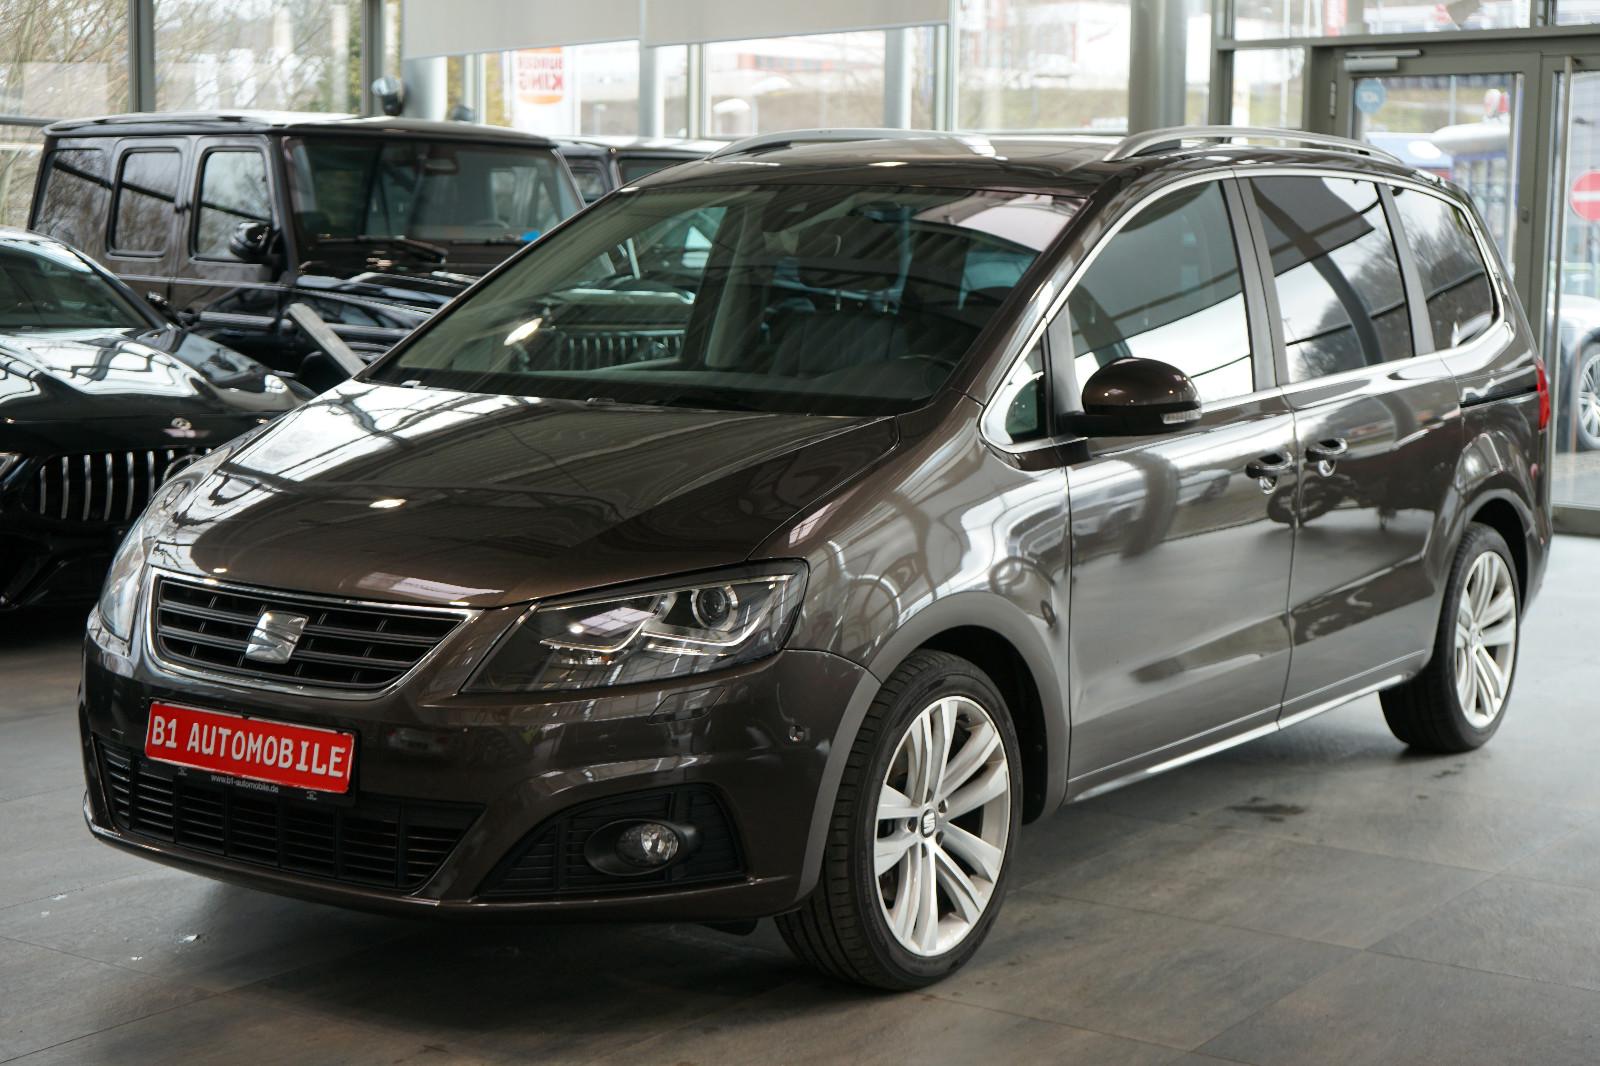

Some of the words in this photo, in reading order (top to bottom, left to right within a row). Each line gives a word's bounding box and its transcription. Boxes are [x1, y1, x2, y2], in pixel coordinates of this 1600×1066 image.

[151, 715, 178, 749] B1
[186, 722, 346, 778] AUTOMOBILE
[210, 774, 279, 793] www.b1-automobile.de
